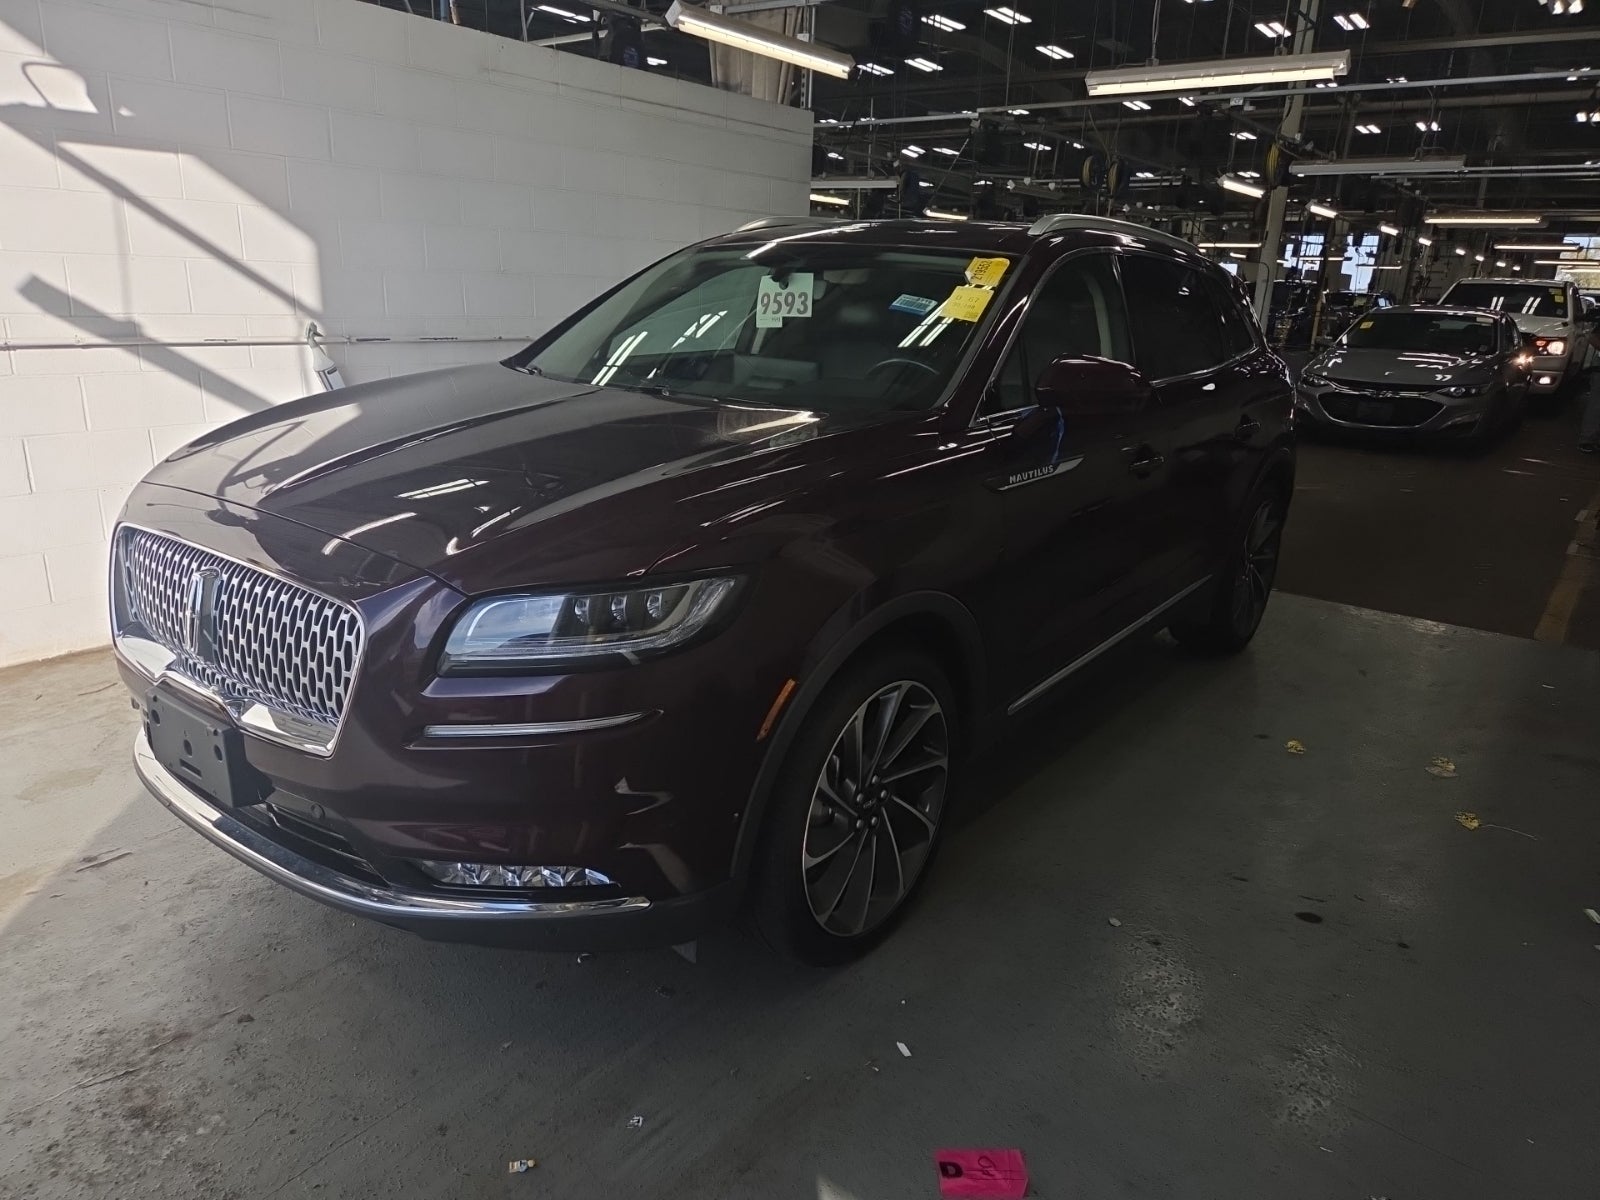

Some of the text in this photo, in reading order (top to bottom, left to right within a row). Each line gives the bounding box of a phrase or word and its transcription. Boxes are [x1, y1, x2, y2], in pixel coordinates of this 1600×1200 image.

[760, 291, 809, 315] 9593
[1009, 464, 1054, 484] NAUTILUS
[939, 1161, 964, 1179] D
